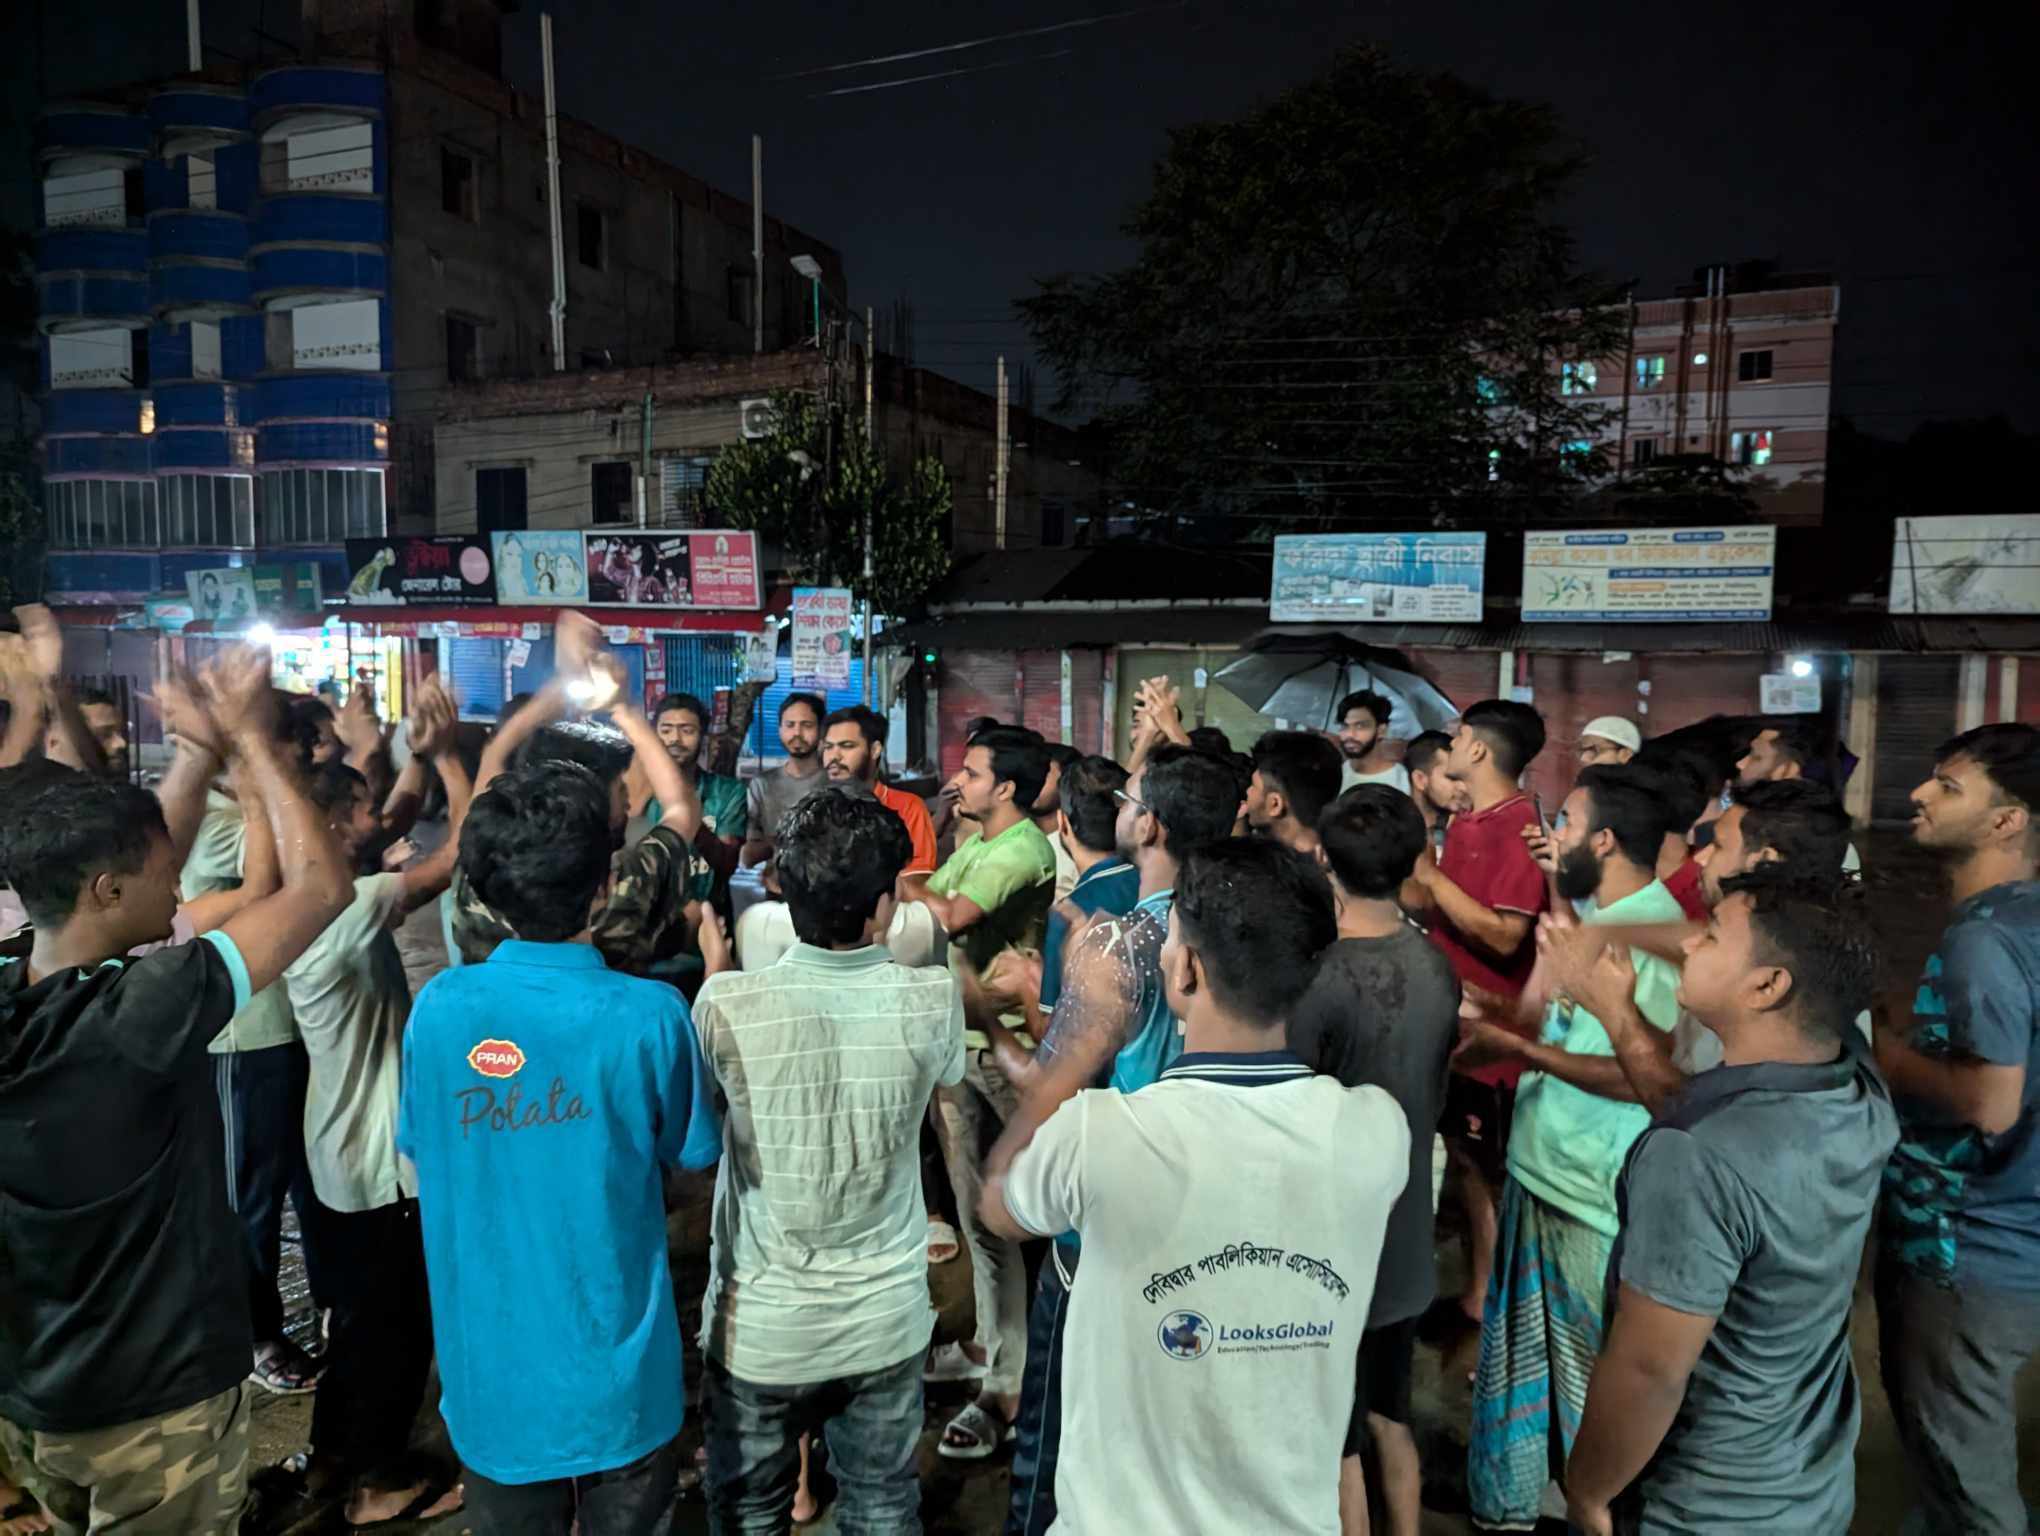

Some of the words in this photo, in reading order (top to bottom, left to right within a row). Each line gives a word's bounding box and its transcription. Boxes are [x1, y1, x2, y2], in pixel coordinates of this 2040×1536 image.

[476, 1051, 518, 1067] PRAN
[455, 1075, 592, 1141] Potata
[1219, 1319, 1334, 1342] LooksGlobal
